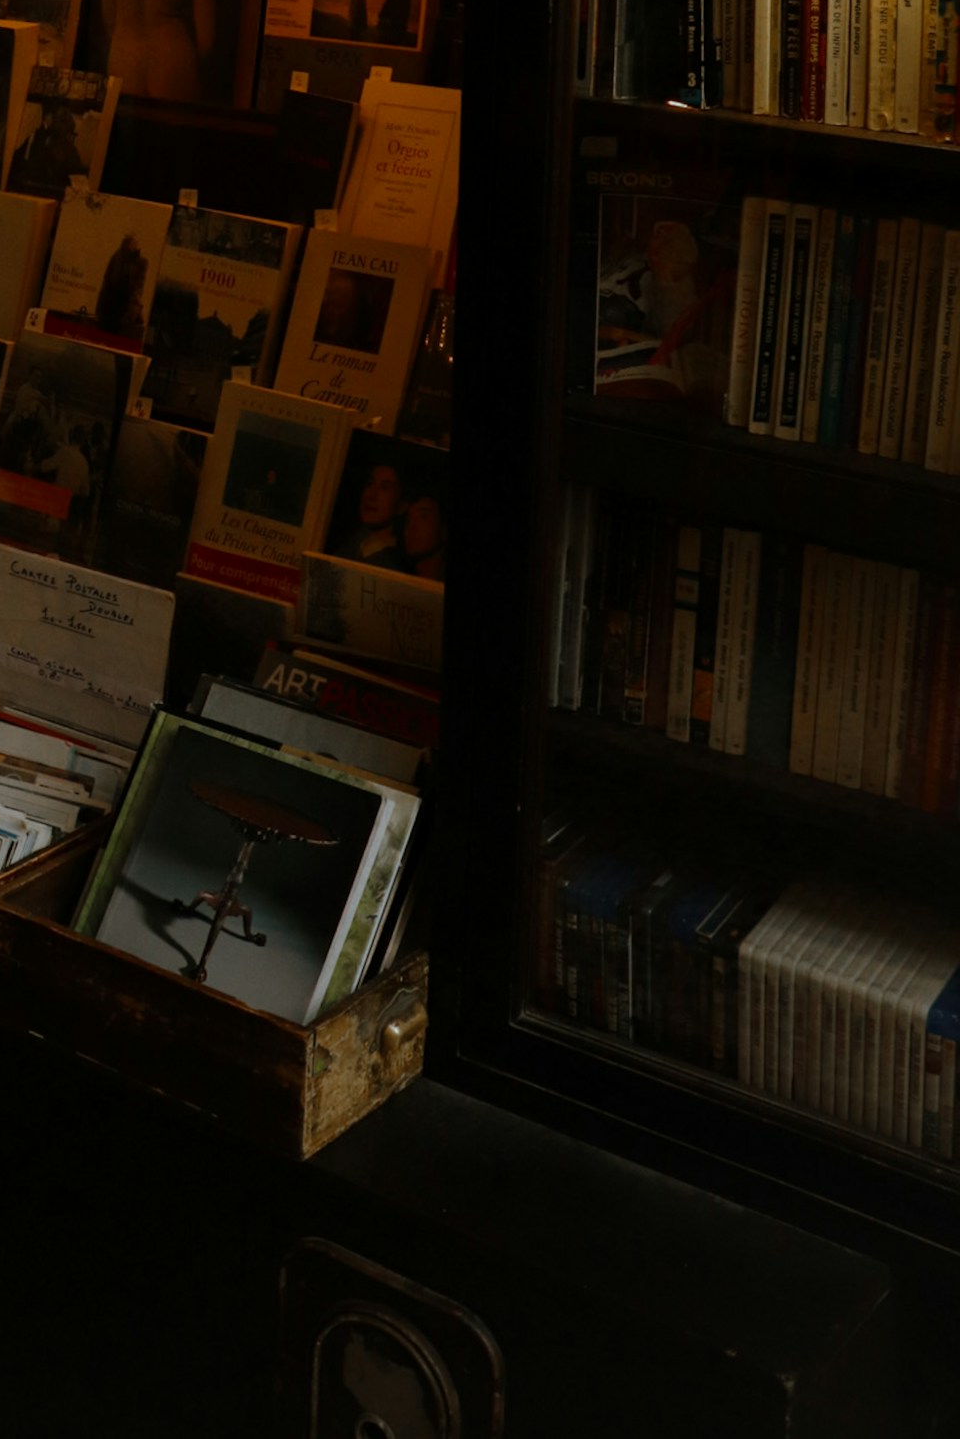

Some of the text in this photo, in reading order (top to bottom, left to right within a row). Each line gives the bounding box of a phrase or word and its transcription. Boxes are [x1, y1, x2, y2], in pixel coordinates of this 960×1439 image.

[810, 15, 821, 29] DU
[809, 31, 820, 62] TEMPS
[878, 28, 889, 64] PERDU
[386, 139, 431, 163] Orgies
[375, 161, 389, 174] et
[585, 171, 673, 189] BEYOND
[332, 248, 401, 275] JEAN CAU
[200, 268, 236, 290] 1900
[814, 259, 828, 300] Goodbye
[308, 345, 378, 374] Le roman
[935, 266, 958, 427] The Blue Hammer Ross Macdonald
[329, 370, 346, 387] de
[299, 384, 370, 414] Carmen
[204, 527, 221, 542] du
[222, 533, 259, 554] Prince
[218, 511, 297, 546] Les Chagrins
[190, 552, 217, 575] Pour
[359, 576, 435, 630] Hommes
[261, 662, 329, 695] ART
